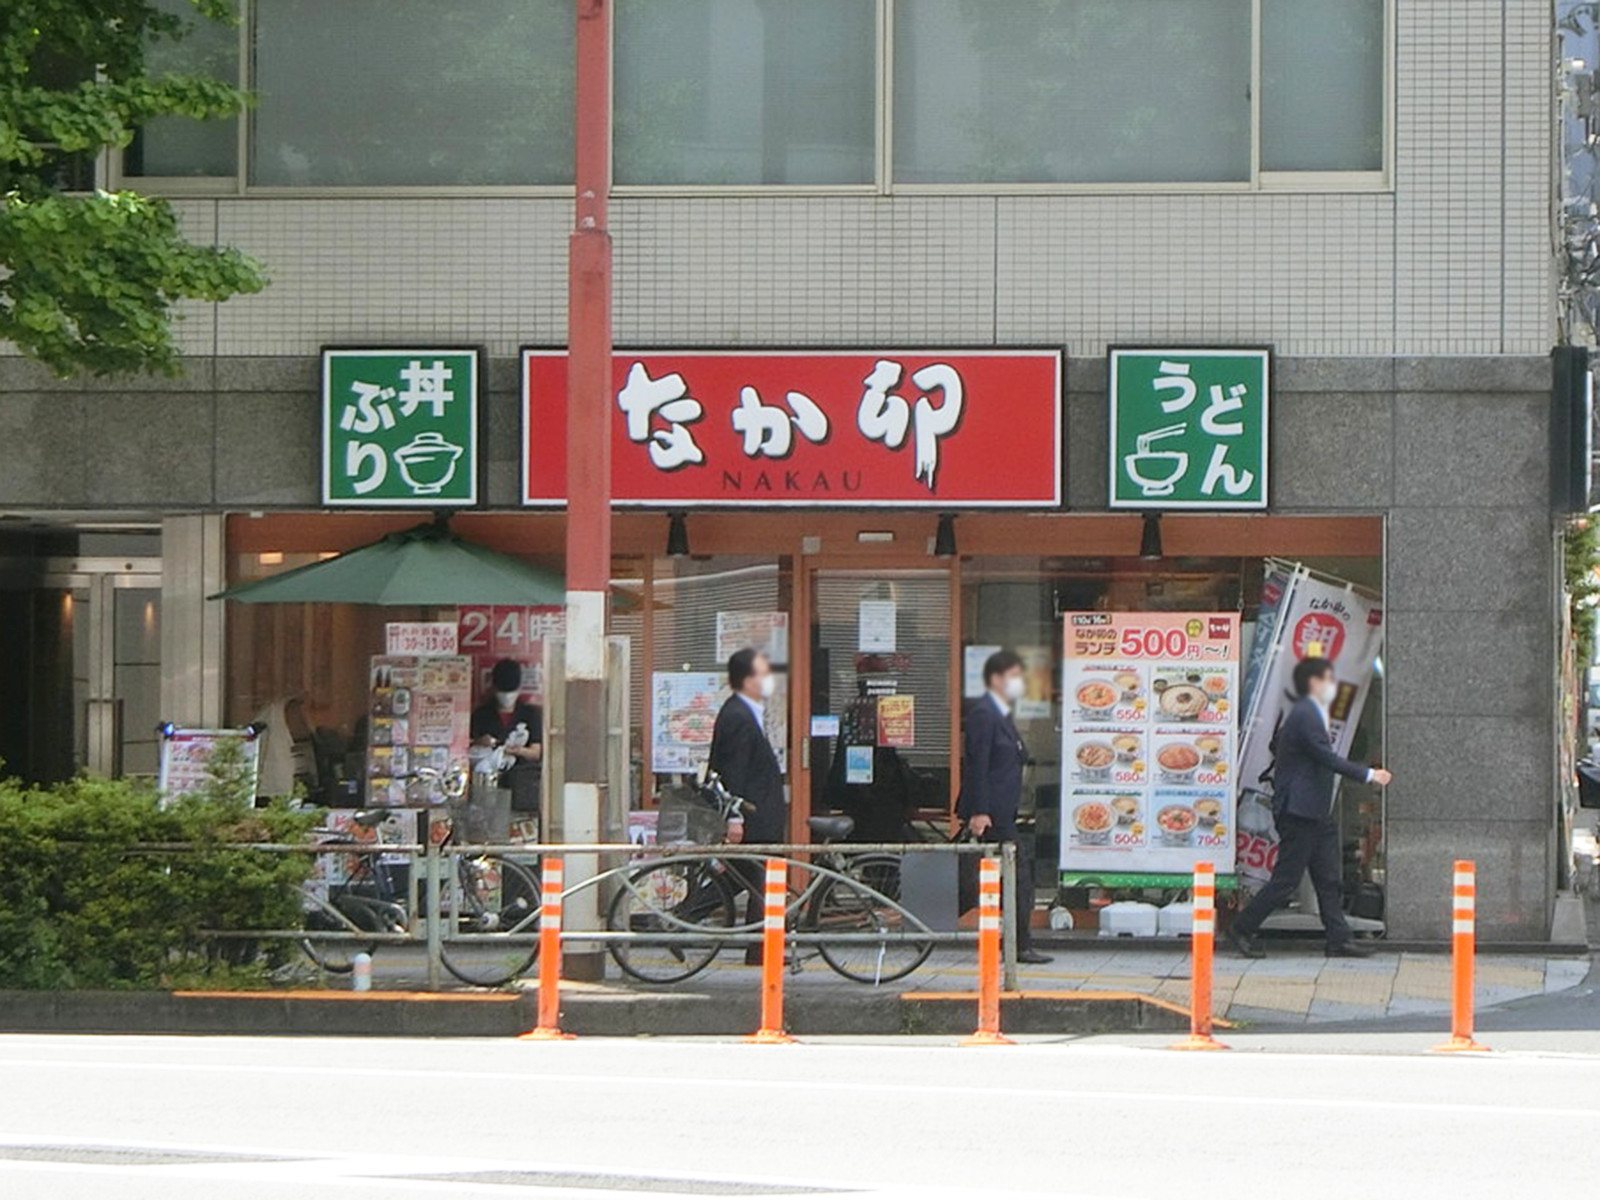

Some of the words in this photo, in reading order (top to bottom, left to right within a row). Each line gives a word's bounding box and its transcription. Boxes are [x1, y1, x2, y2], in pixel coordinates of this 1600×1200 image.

[340, 361, 454, 494] 丼ぶり
[618, 360, 964, 492] なか卯
[721, 471, 862, 491] NAKAU
[1153, 361, 1254, 495] うどん
